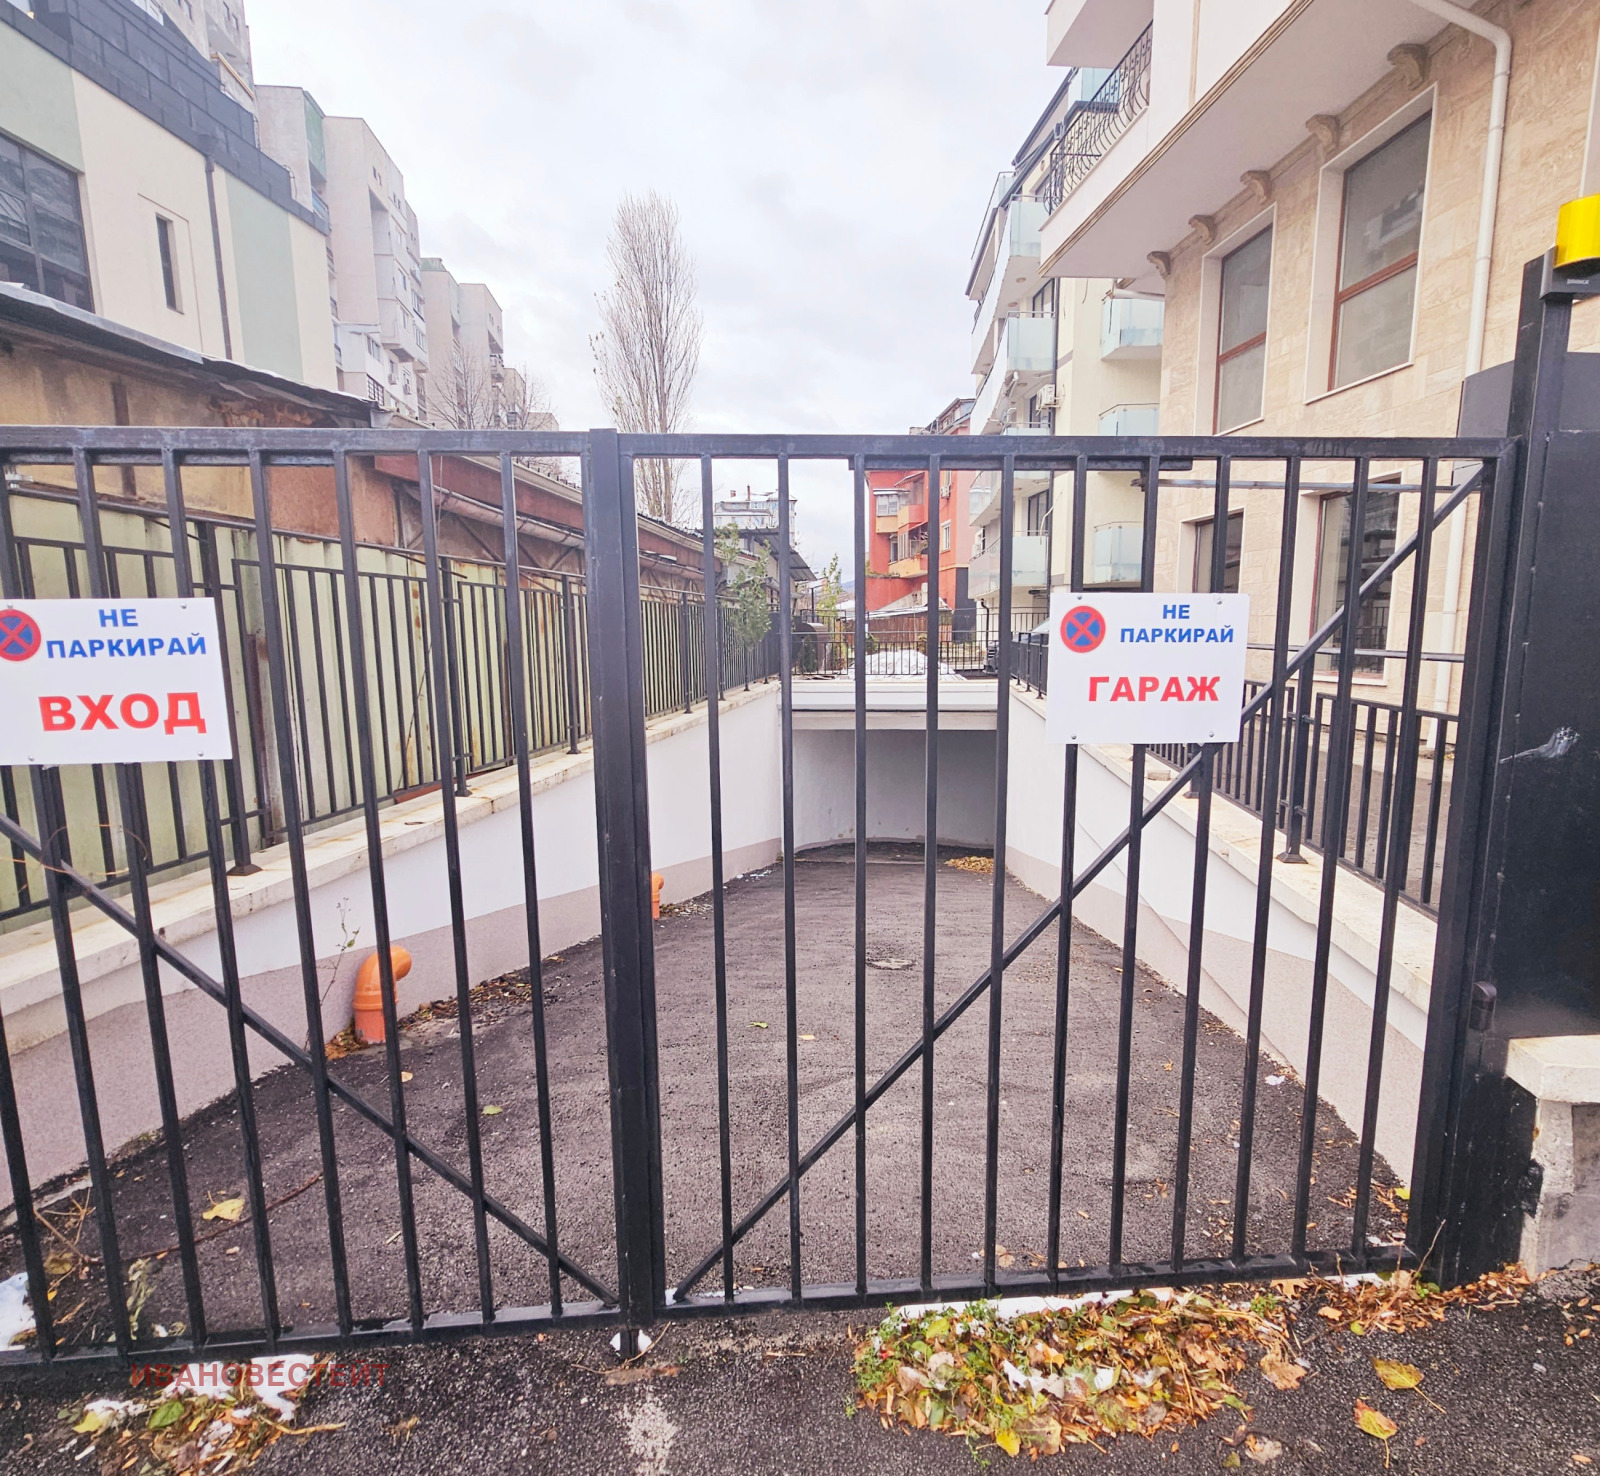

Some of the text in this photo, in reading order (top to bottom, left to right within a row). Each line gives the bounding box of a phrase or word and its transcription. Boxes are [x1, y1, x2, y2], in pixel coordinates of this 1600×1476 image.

[98, 608, 139, 628] НЕ
[1162, 604, 1190, 620] НЕ
[1120, 624, 1234, 643] ПАРКИРАЙ
[46, 632, 207, 659] ПАРКИРАЙ
[1088, 676, 1221, 702] ГАРАЖ
[38, 692, 207, 735] ВХОД
